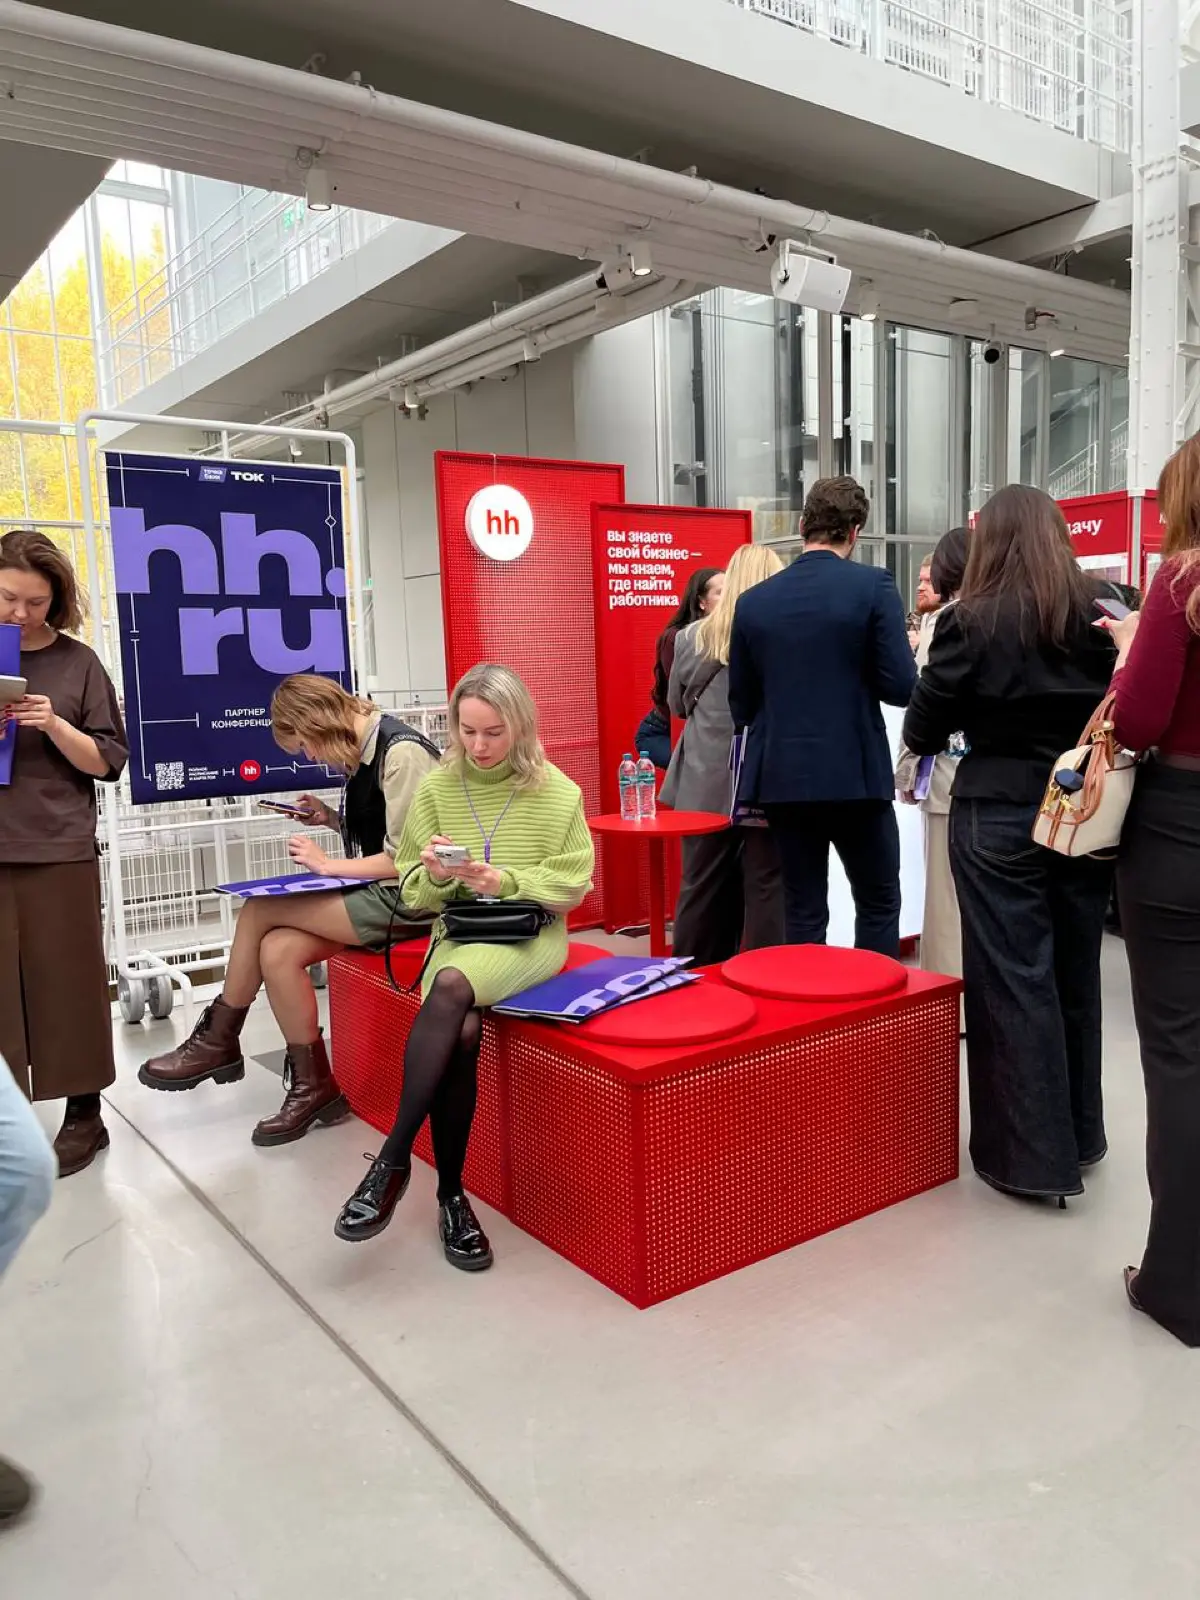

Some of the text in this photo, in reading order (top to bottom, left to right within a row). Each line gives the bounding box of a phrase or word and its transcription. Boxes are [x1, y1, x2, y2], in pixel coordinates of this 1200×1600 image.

[486, 509, 520, 535] hh
[607, 530, 672, 543] вы знаете
[607, 544, 640, 557] свой
[642, 545, 688, 559] бизнес
[608, 563, 675, 578] мы знаем,
[609, 577, 672, 592] где найти
[609, 592, 679, 609] работника
[178, 607, 346, 676] ru
[225, 708, 266, 717] ПАРТНЕР
[244, 766, 257, 775] hh
